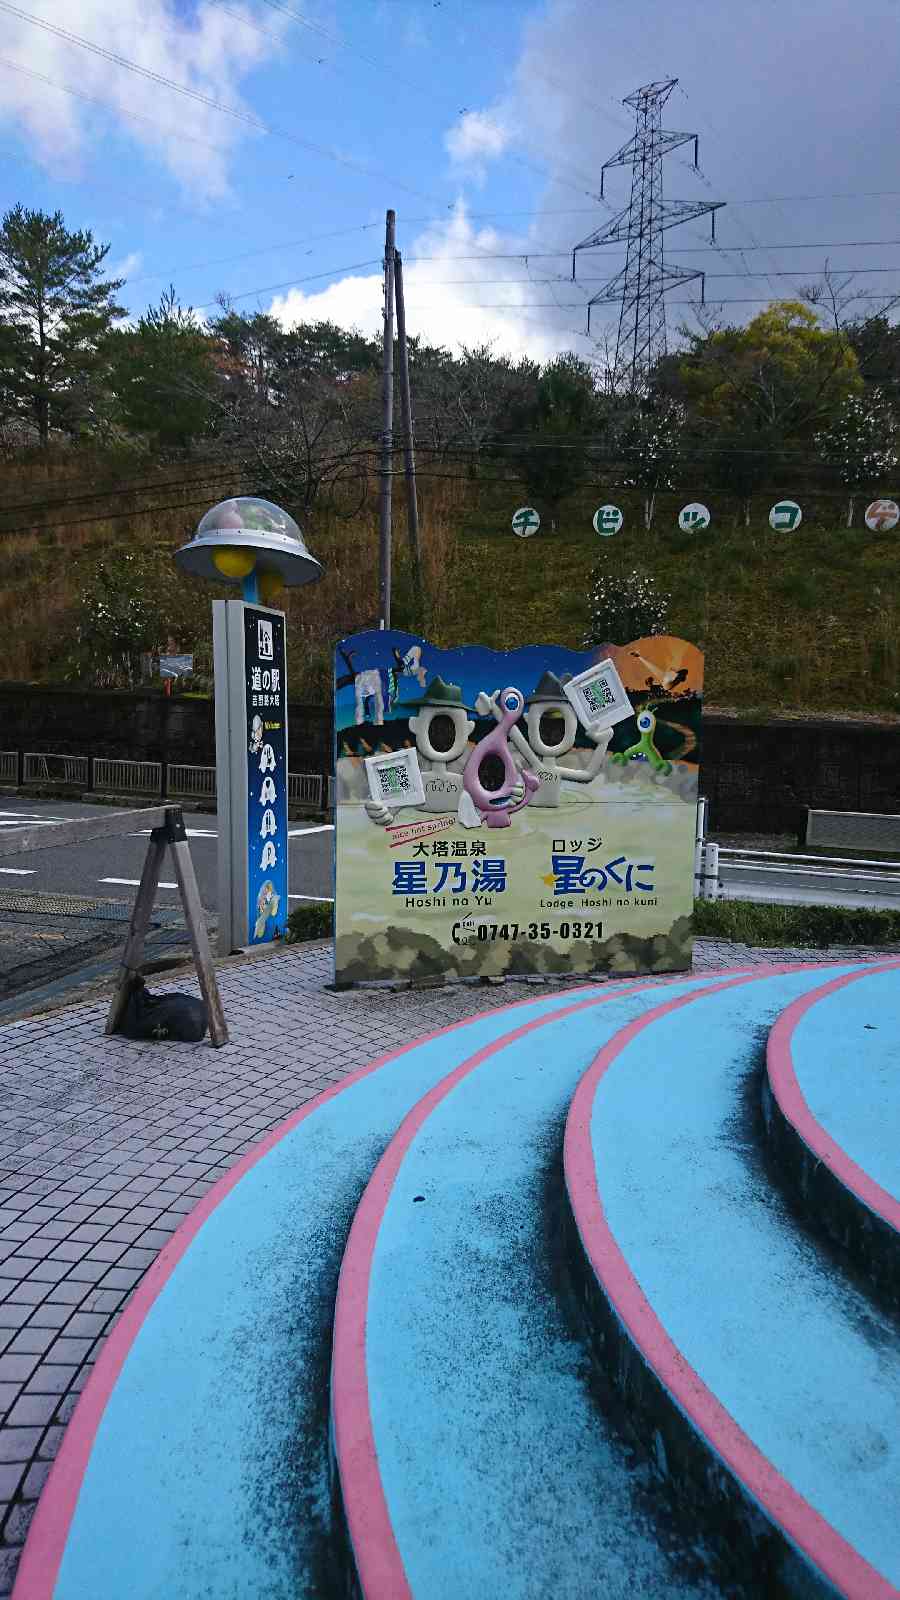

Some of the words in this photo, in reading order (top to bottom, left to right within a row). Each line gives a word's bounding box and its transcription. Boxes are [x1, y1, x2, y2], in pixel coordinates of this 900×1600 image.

[251, 666, 280, 692] 道の駅
[412, 840, 487, 857] 大塔温泉
[552, 838, 602, 852] ロッジ
[391, 860, 507, 894] 星乃湯
[551, 855, 655, 895] 星のくに
[405, 896, 446, 907] Hoshi
[452, 897, 468, 906] no
[474, 895, 492, 906] Yu
[540, 899, 574, 909] Lodge
[581, 898, 612, 907] Hoshi
[616, 898, 630, 906] no
[634, 897, 657, 906] kuni
[478, 921, 603, 941] 0747-35-0321
